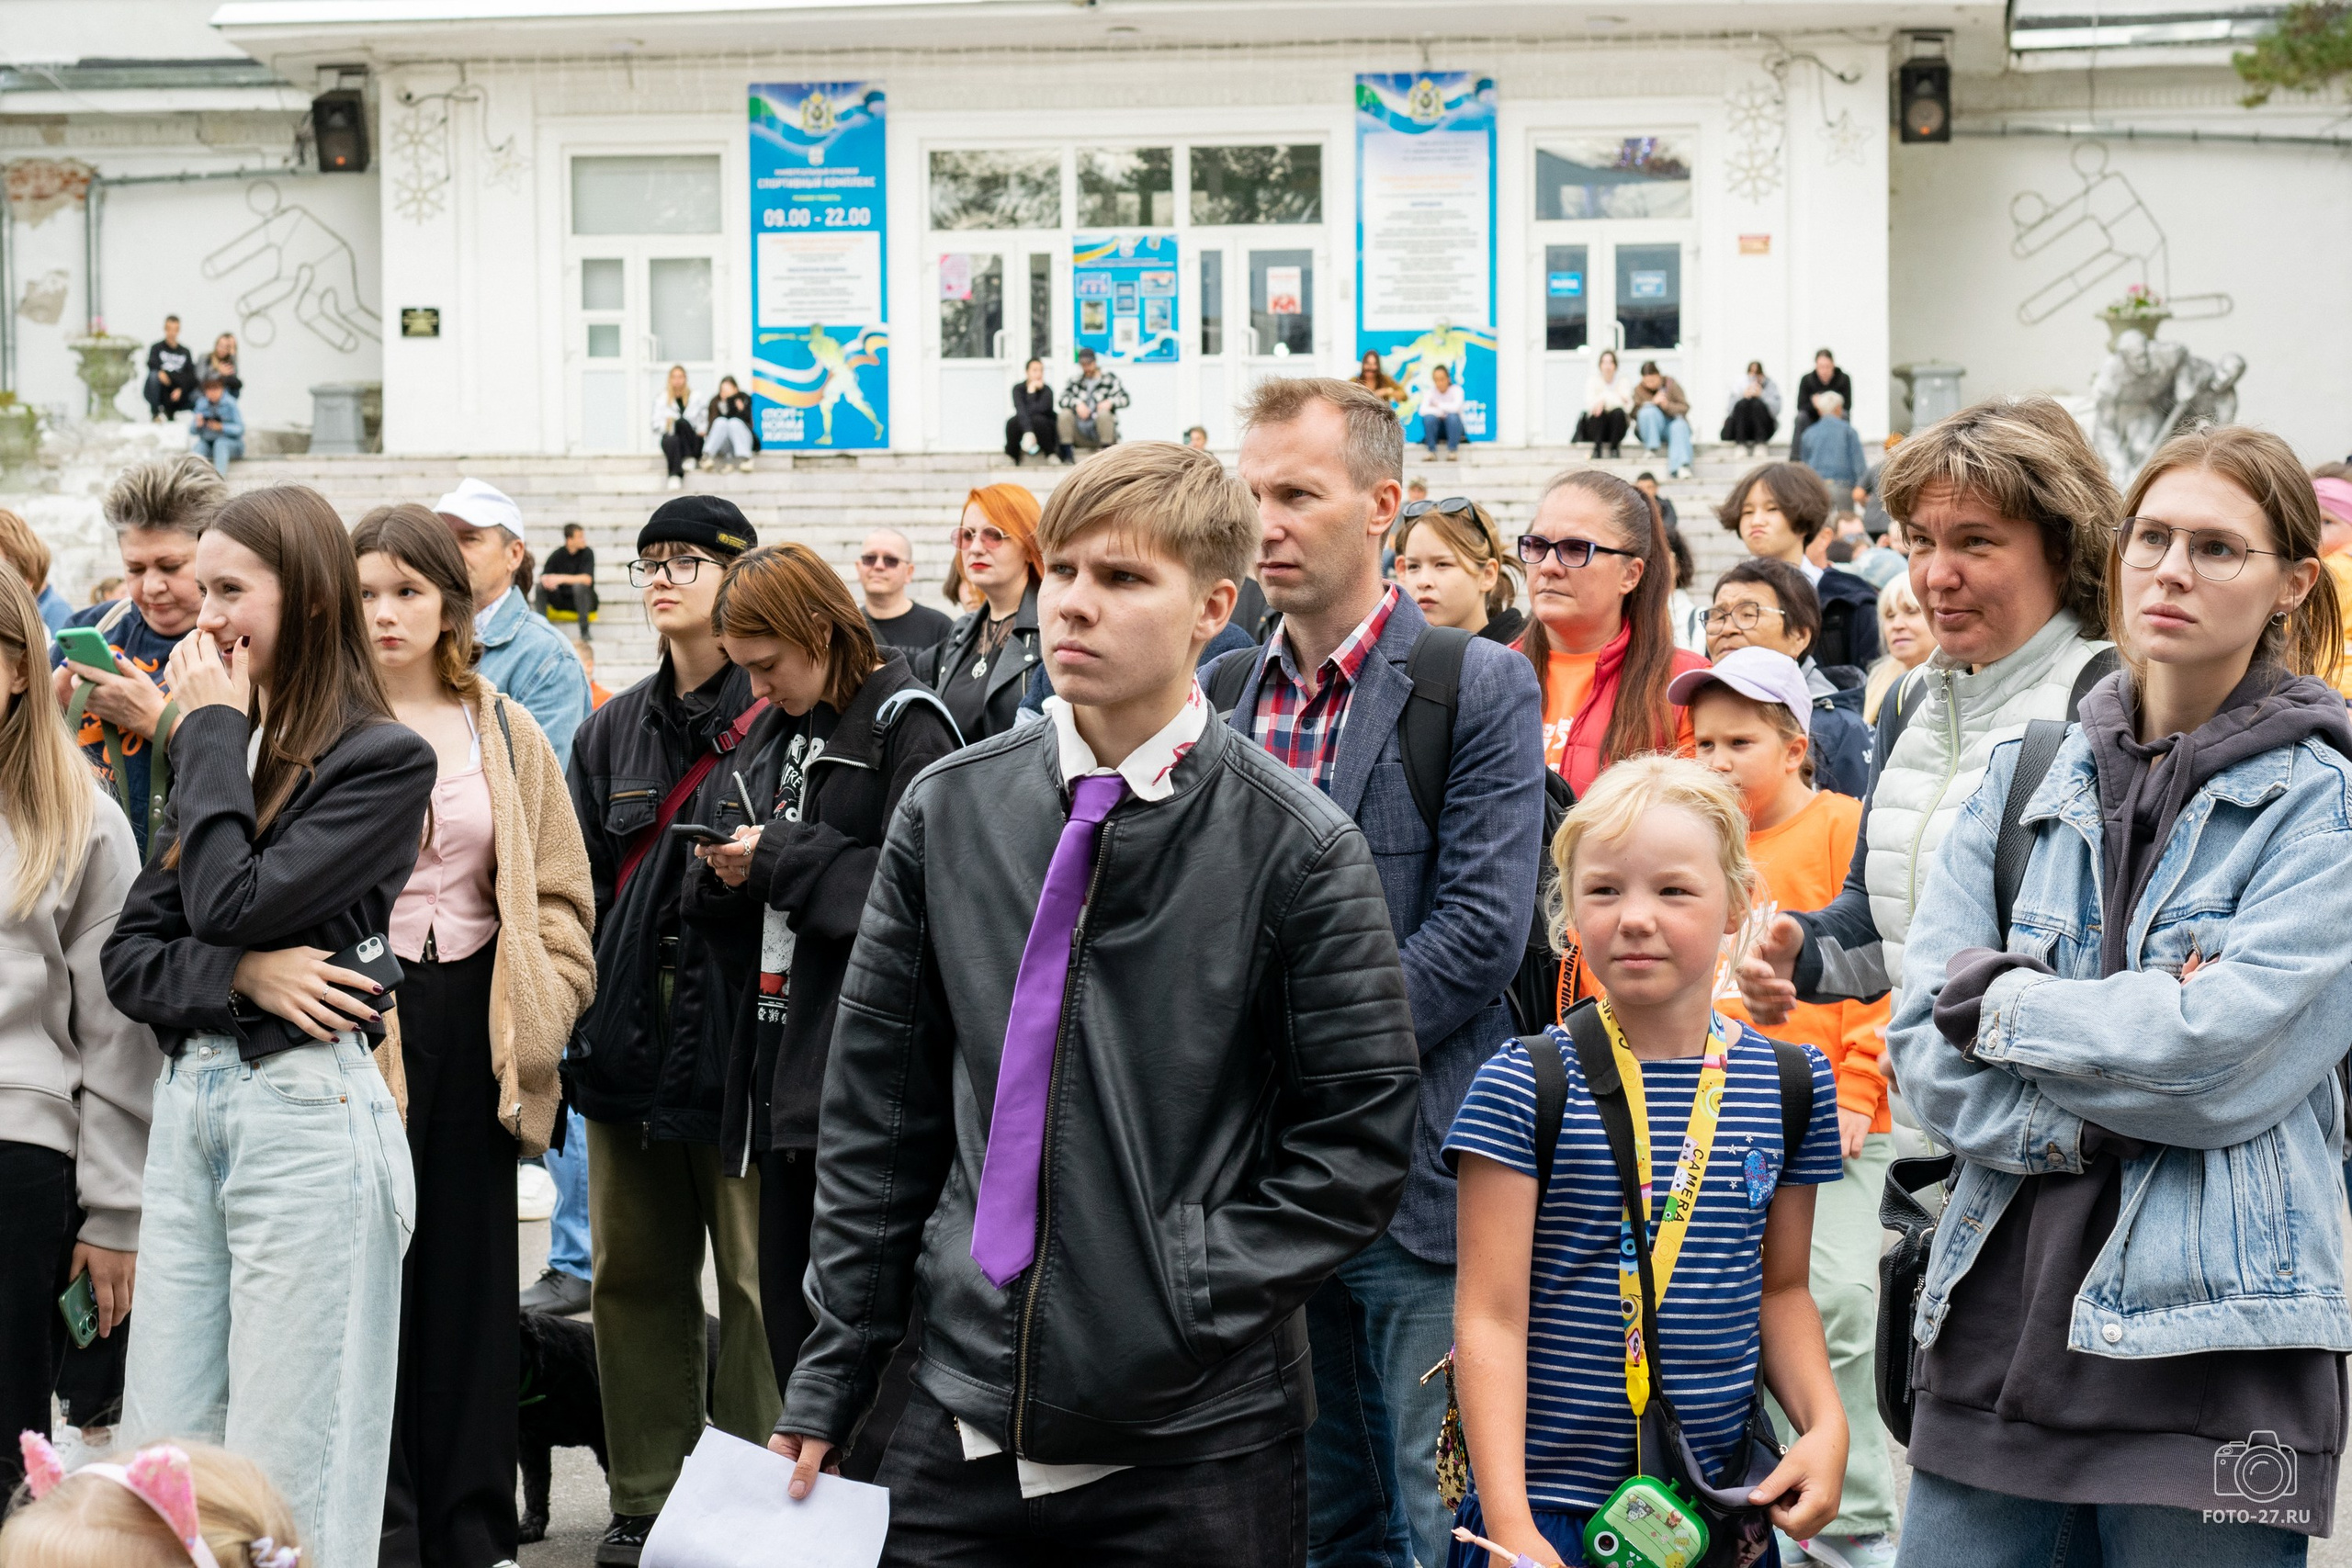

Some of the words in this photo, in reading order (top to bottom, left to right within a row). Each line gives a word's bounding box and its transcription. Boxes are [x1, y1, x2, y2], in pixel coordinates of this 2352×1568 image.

[763, 208, 811, 228] 09.00
[824, 207, 871, 226] 22.00
[1561, 945, 1578, 1011] Hyperlin
[1673, 1148, 1704, 1222] CAMERA
